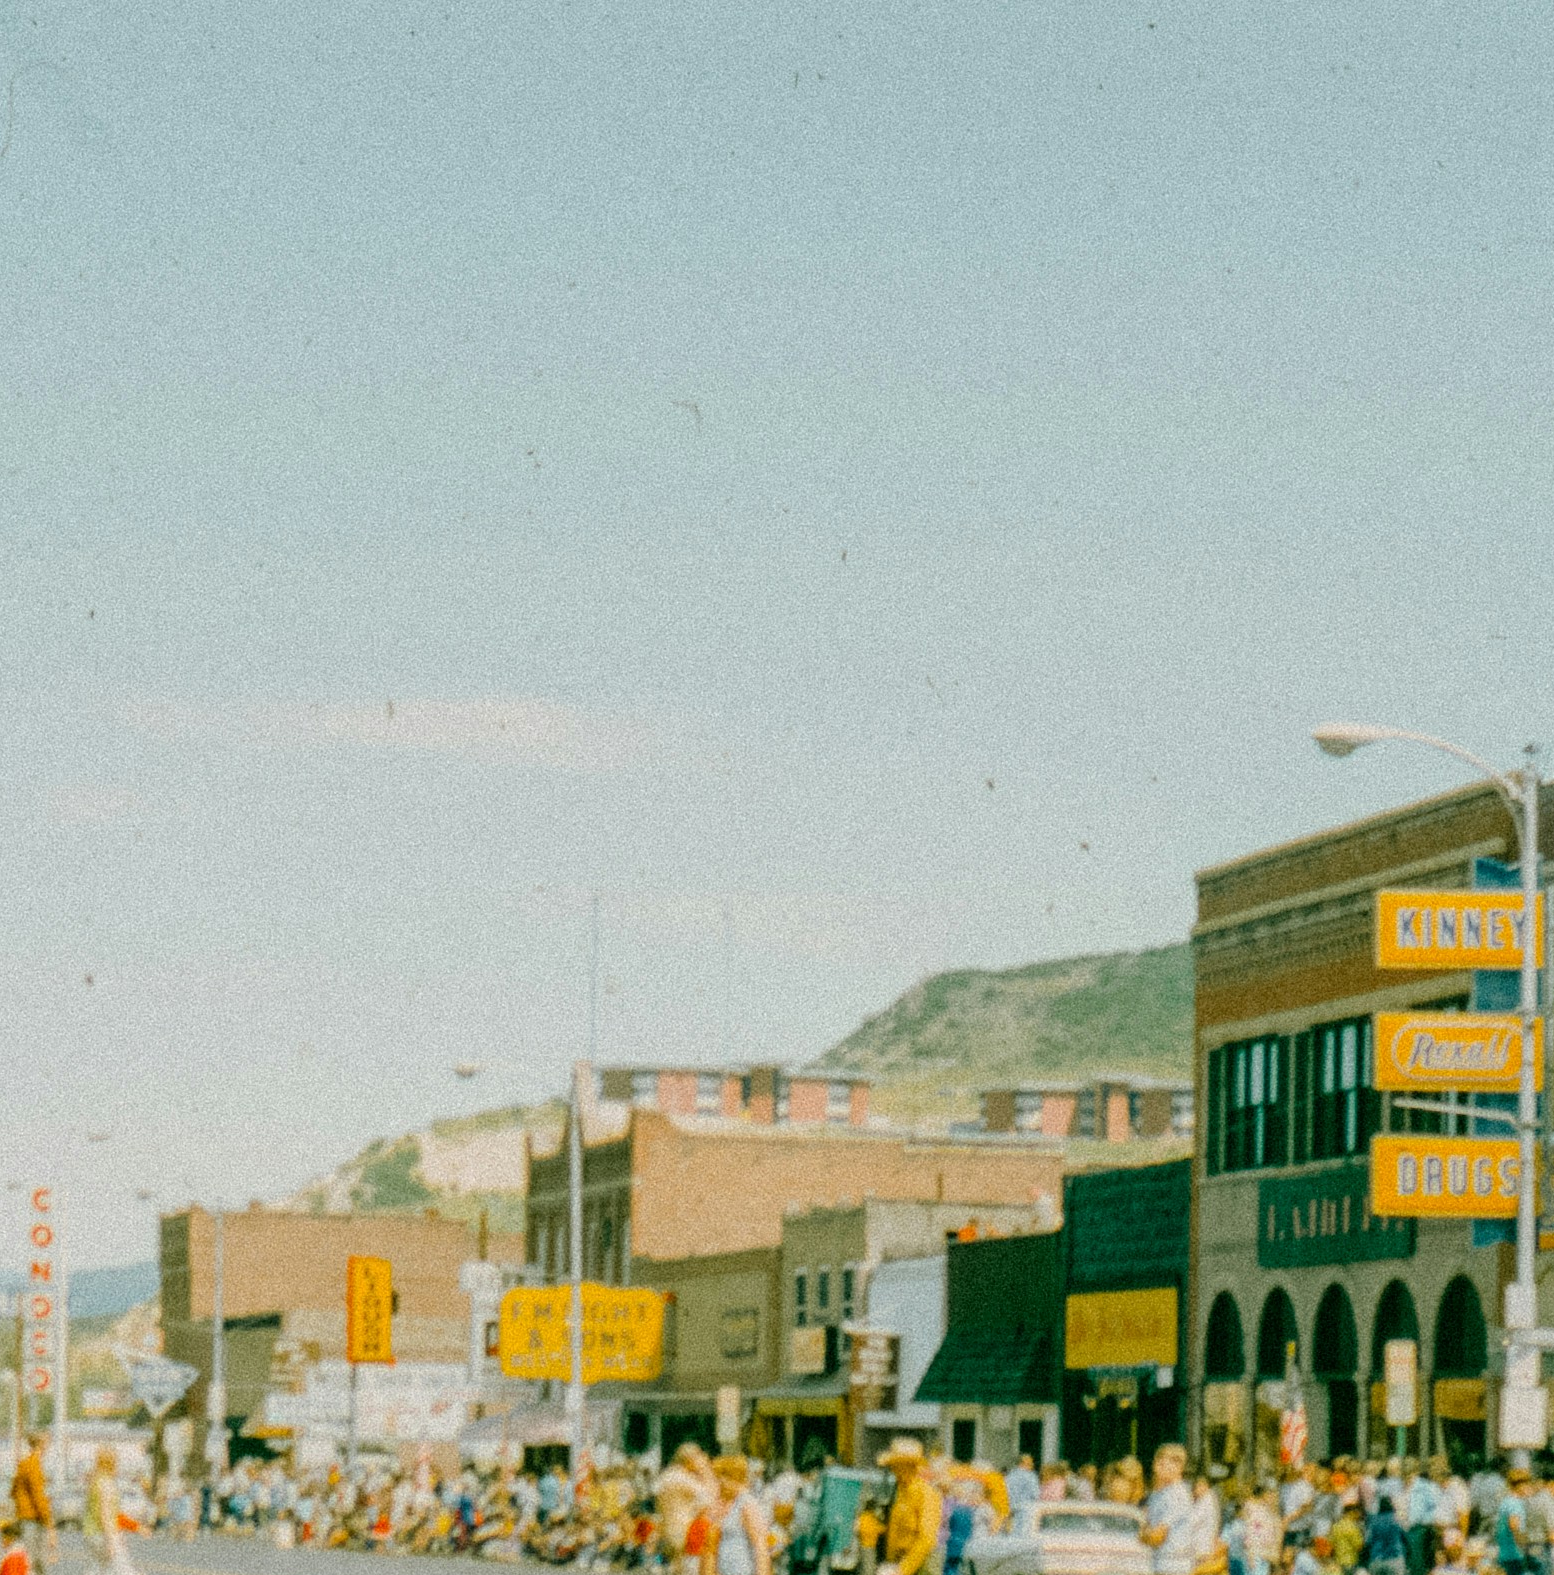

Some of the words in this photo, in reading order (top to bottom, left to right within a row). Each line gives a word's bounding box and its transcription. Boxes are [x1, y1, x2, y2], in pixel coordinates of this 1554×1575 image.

[1397, 907, 1526, 949] KINNEY
[1407, 1031, 1513, 1070] Rexall
[1397, 1154, 1521, 1199] DRUGS
[30, 1187, 54, 1391] CONOCO
